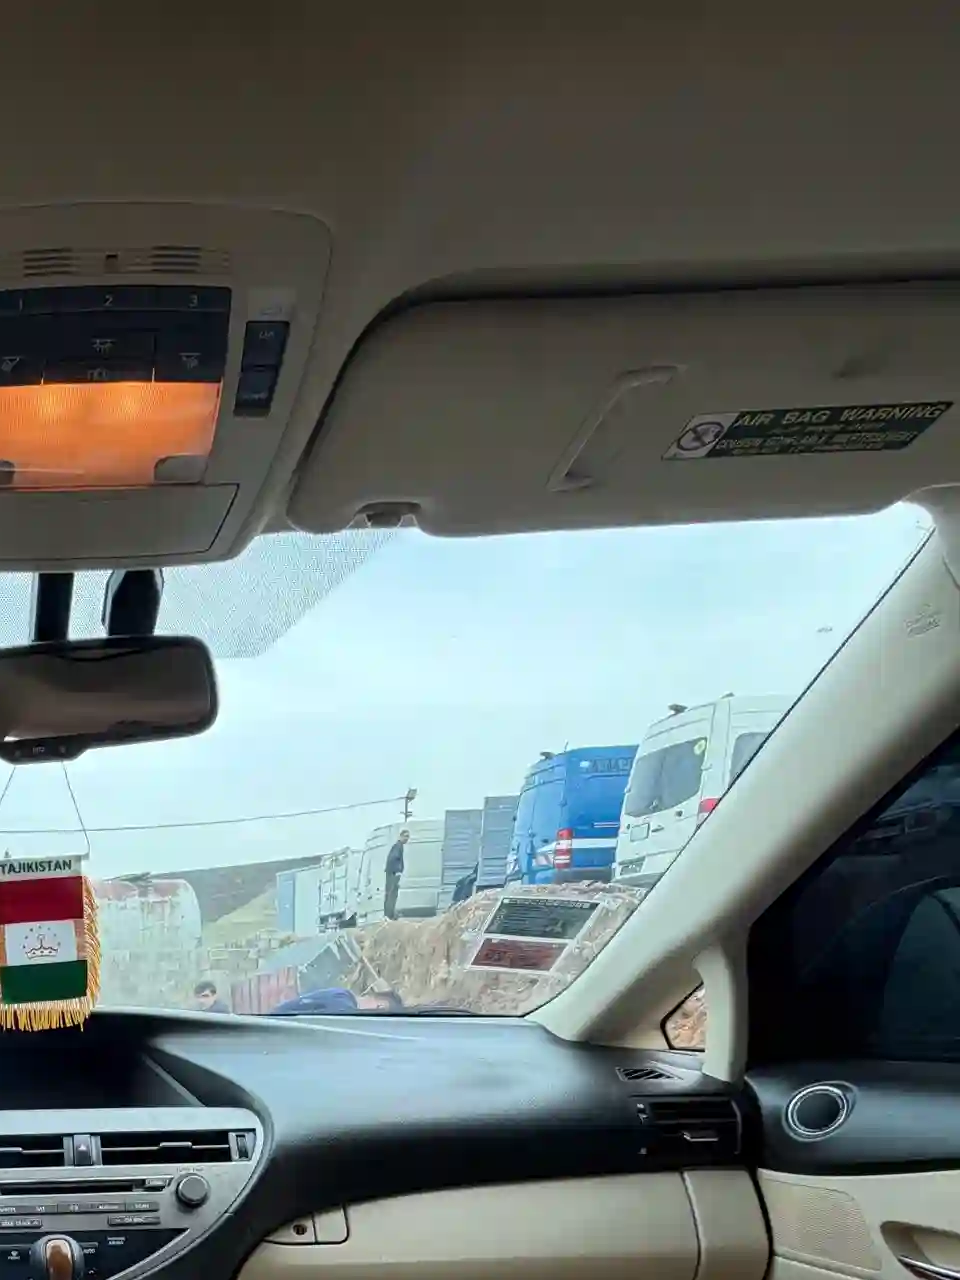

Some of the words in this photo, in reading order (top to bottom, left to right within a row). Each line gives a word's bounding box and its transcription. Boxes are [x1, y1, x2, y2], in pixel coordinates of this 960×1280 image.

[103, 294, 114, 307] 2
[189, 294, 199, 308] 3
[736, 412, 775, 428] AIR
[781, 409, 828, 425] BAG
[841, 403, 947, 422] WARNING
